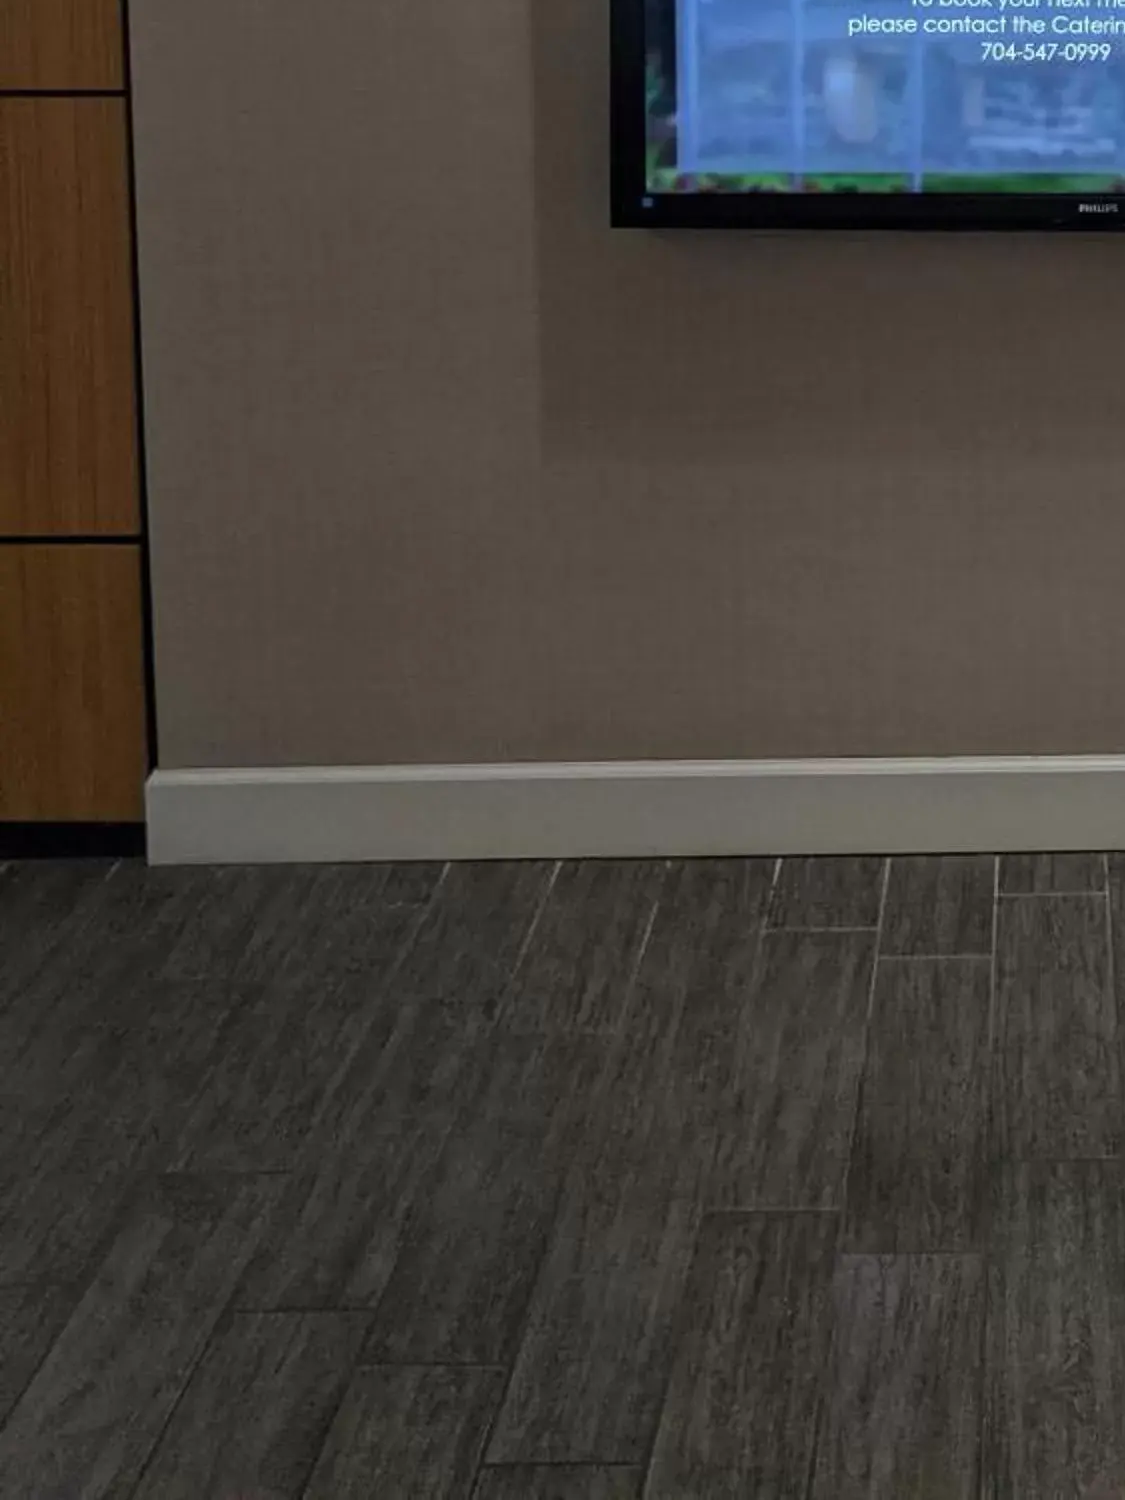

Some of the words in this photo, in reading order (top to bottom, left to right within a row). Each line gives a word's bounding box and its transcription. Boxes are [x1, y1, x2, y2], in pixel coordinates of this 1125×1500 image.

[848, 14, 918, 38] please
[923, 16, 1008, 34] contact
[1012, 16, 1046, 35] the
[981, 42, 1112, 62] 704-547-0999
